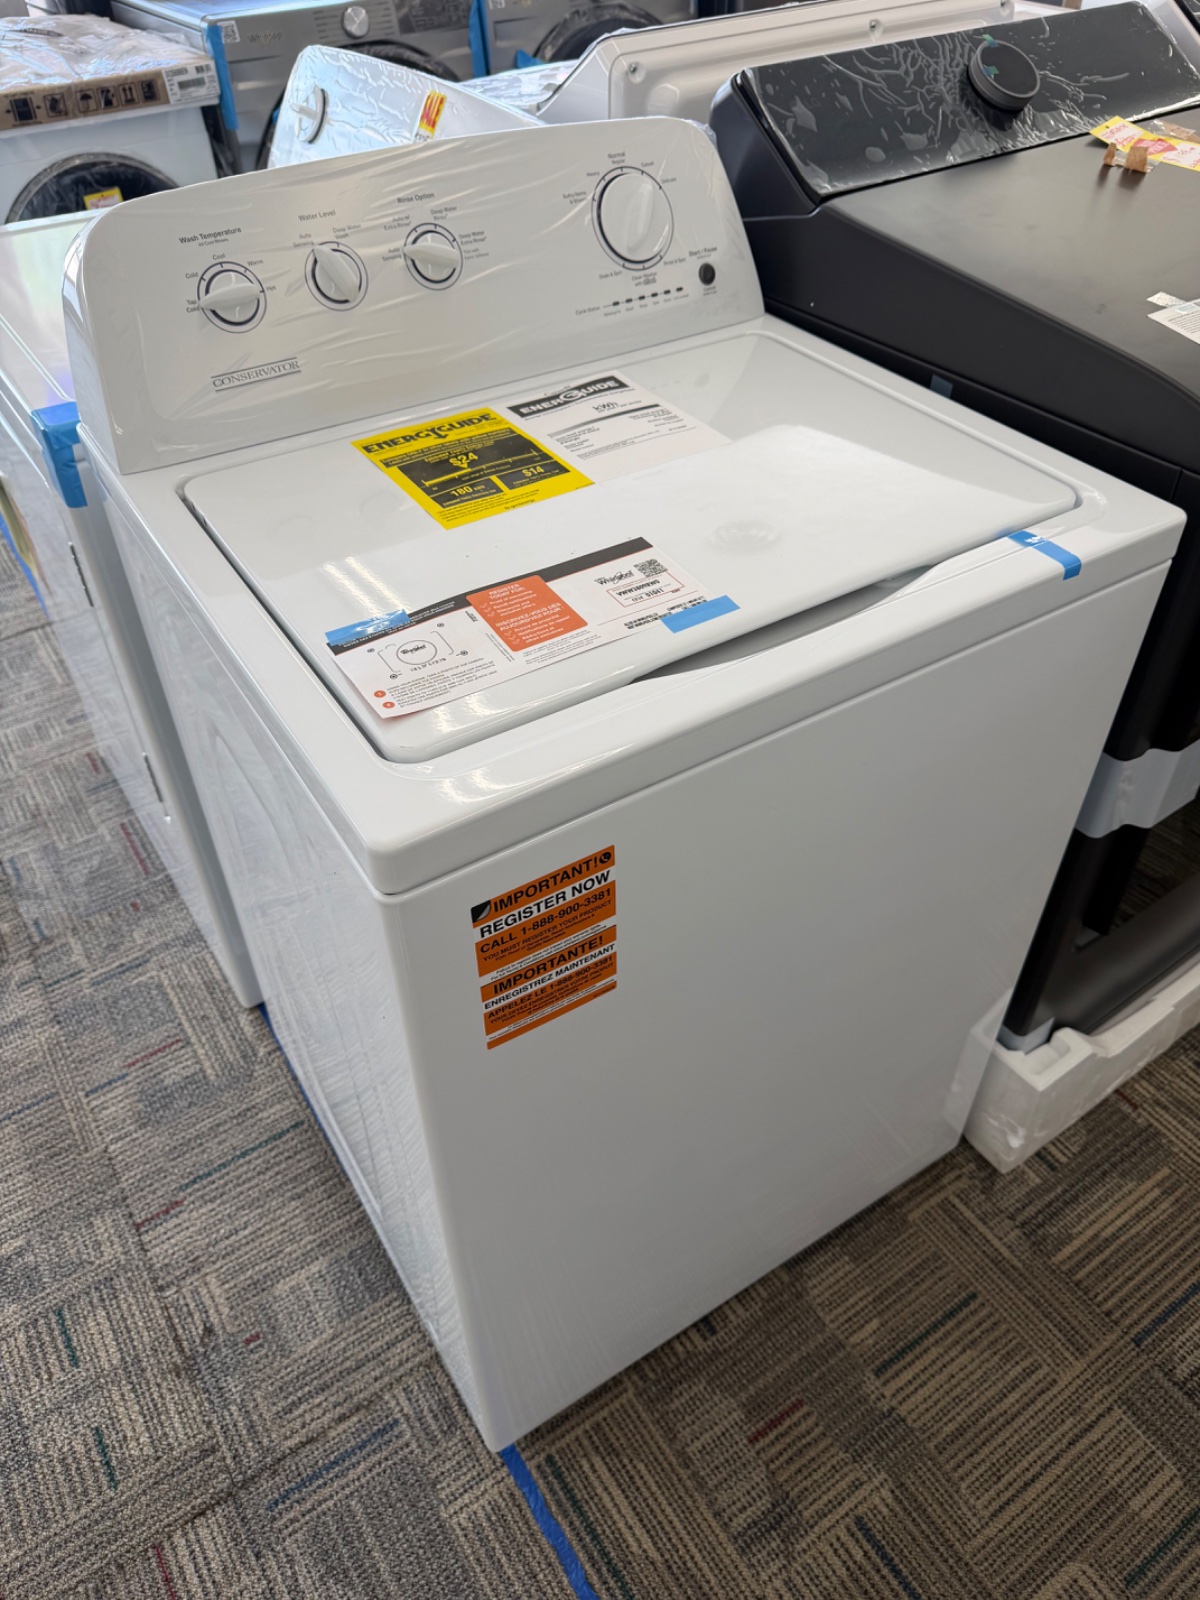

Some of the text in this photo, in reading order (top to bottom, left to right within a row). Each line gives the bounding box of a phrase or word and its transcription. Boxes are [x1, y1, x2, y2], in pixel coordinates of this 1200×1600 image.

[397, 192, 435, 204] Rinse Option
[298, 209, 336, 222] Water Level
[179, 227, 242, 244] Wash Temperature
[299, 232, 312, 240] Auto
[212, 253, 226, 261] Cool
[247, 259, 264, 267] Warm
[185, 271, 199, 279] Cold
[186, 306, 201, 314] Cold
[212, 360, 300, 388] CONSERVATOR
[519, 379, 620, 415] ENERGUIDE
[592, 401, 618, 412] kWh
[449, 452, 479, 467] $24
[522, 466, 545, 477] $14
[594, 570, 634, 585] Whirlpool
[493, 857, 598, 913] IMPORTANT!
[480, 869, 610, 939] REGISTER NOW
[480, 930, 516, 954] CALL
[521, 886, 610, 936] 1-888-900-3381
[483, 898, 611, 962] YOU MUST REGISTER YOUR PRODUCT
[493, 934, 602, 995] IMPORTANTE!
[484, 972, 553, 1010] ENREGISTREZ
[555, 943, 614, 977] MAINTENANT
[488, 993, 532, 1019] APPELEZ
[534, 986, 546, 997] LE
[549, 954, 612, 990] 1-888-900-3381
